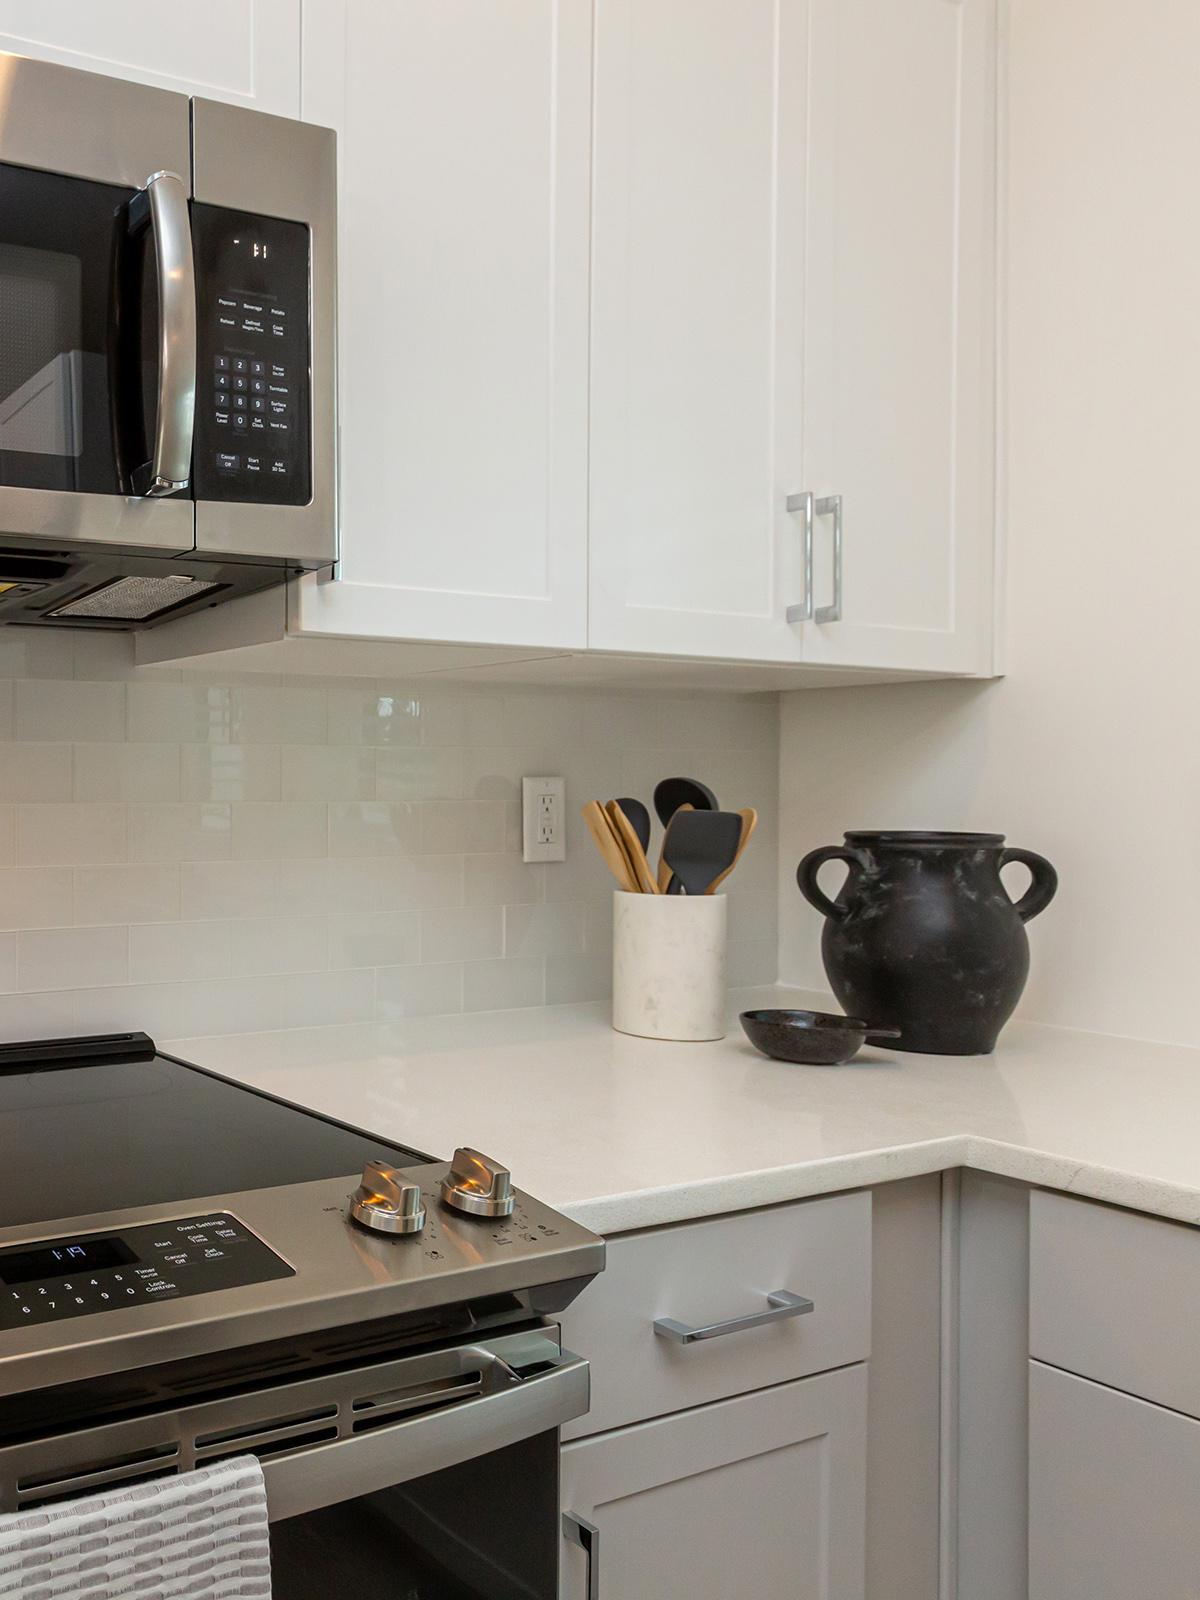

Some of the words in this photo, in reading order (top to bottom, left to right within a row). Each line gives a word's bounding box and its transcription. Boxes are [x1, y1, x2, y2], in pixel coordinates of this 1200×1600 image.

[243, 303, 262, 311] Beverage
[195, 1220, 226, 1229] Settings
[154, 1240, 172, 1248] Start
[52, 1245, 86, 1260] 1:19
[164, 1253, 188, 1261] Cancel
[38, 1287, 47, 1295] 2
[145, 1283, 176, 1292] Controls
